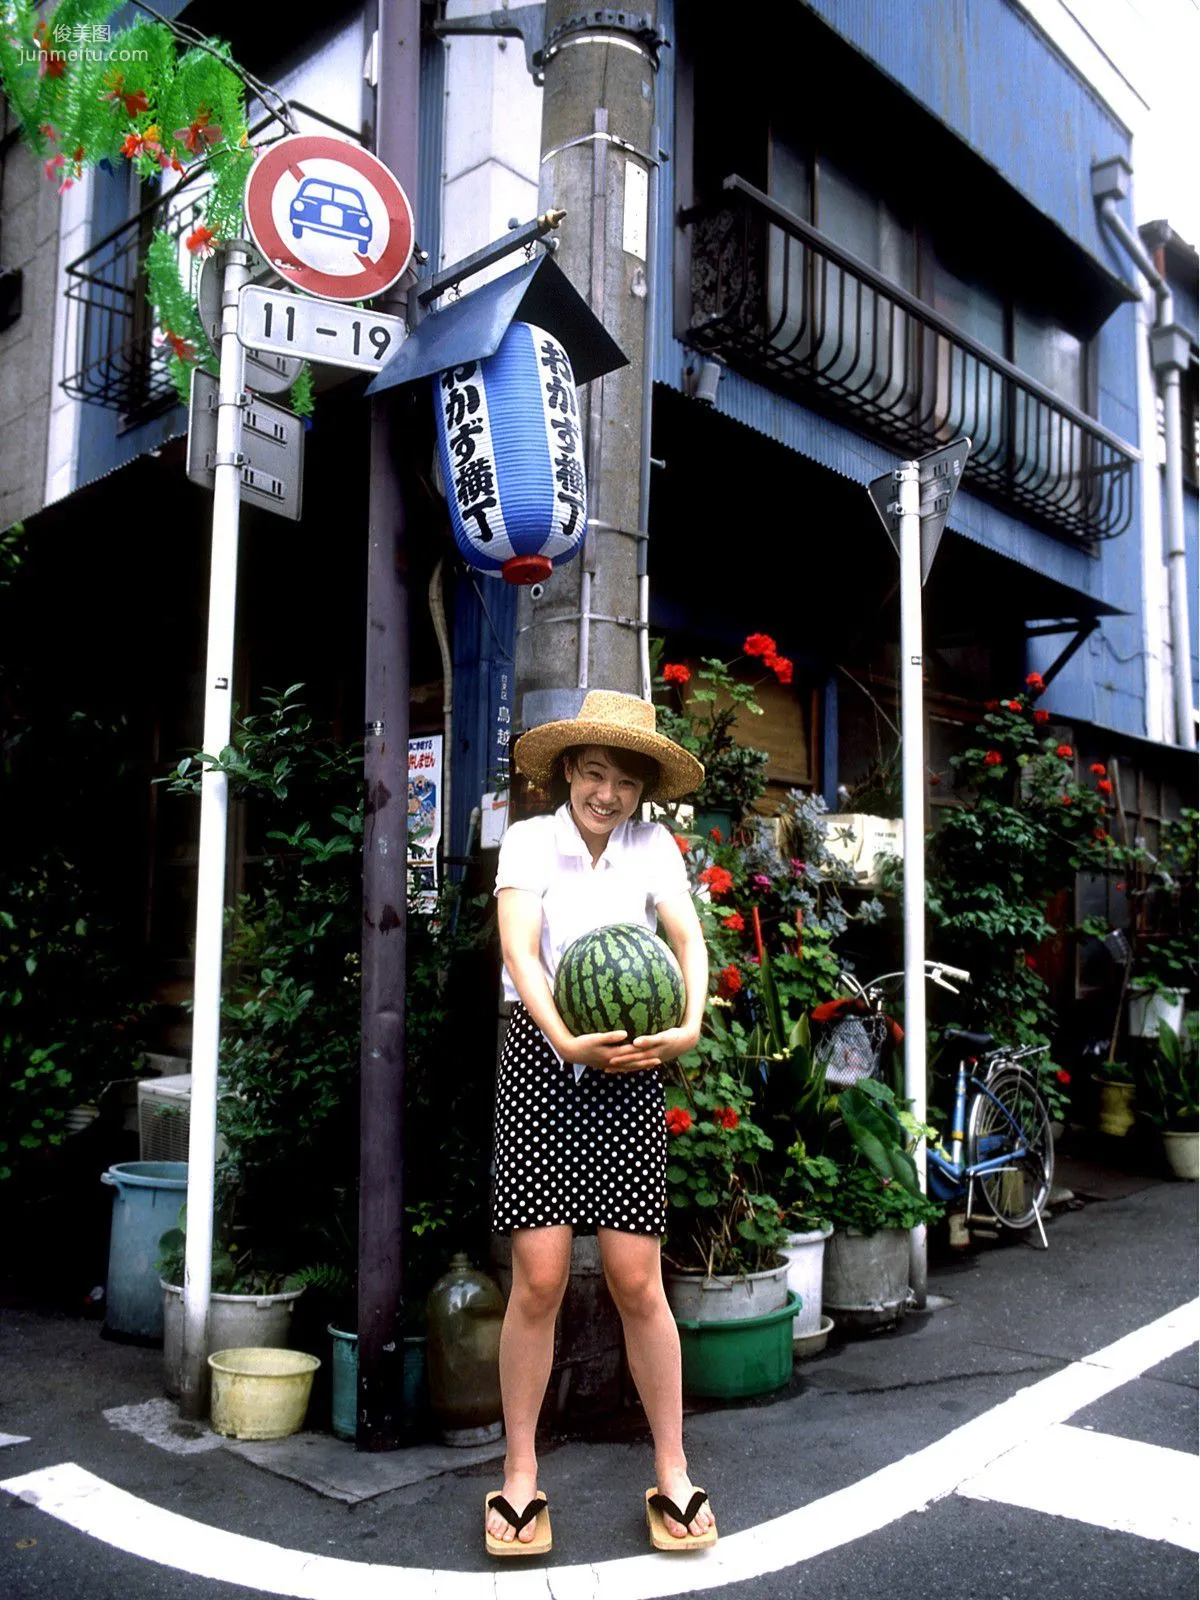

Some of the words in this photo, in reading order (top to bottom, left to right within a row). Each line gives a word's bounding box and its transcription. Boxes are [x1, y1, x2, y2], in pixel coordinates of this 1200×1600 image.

[541, 339, 585, 536] おかず横丁
